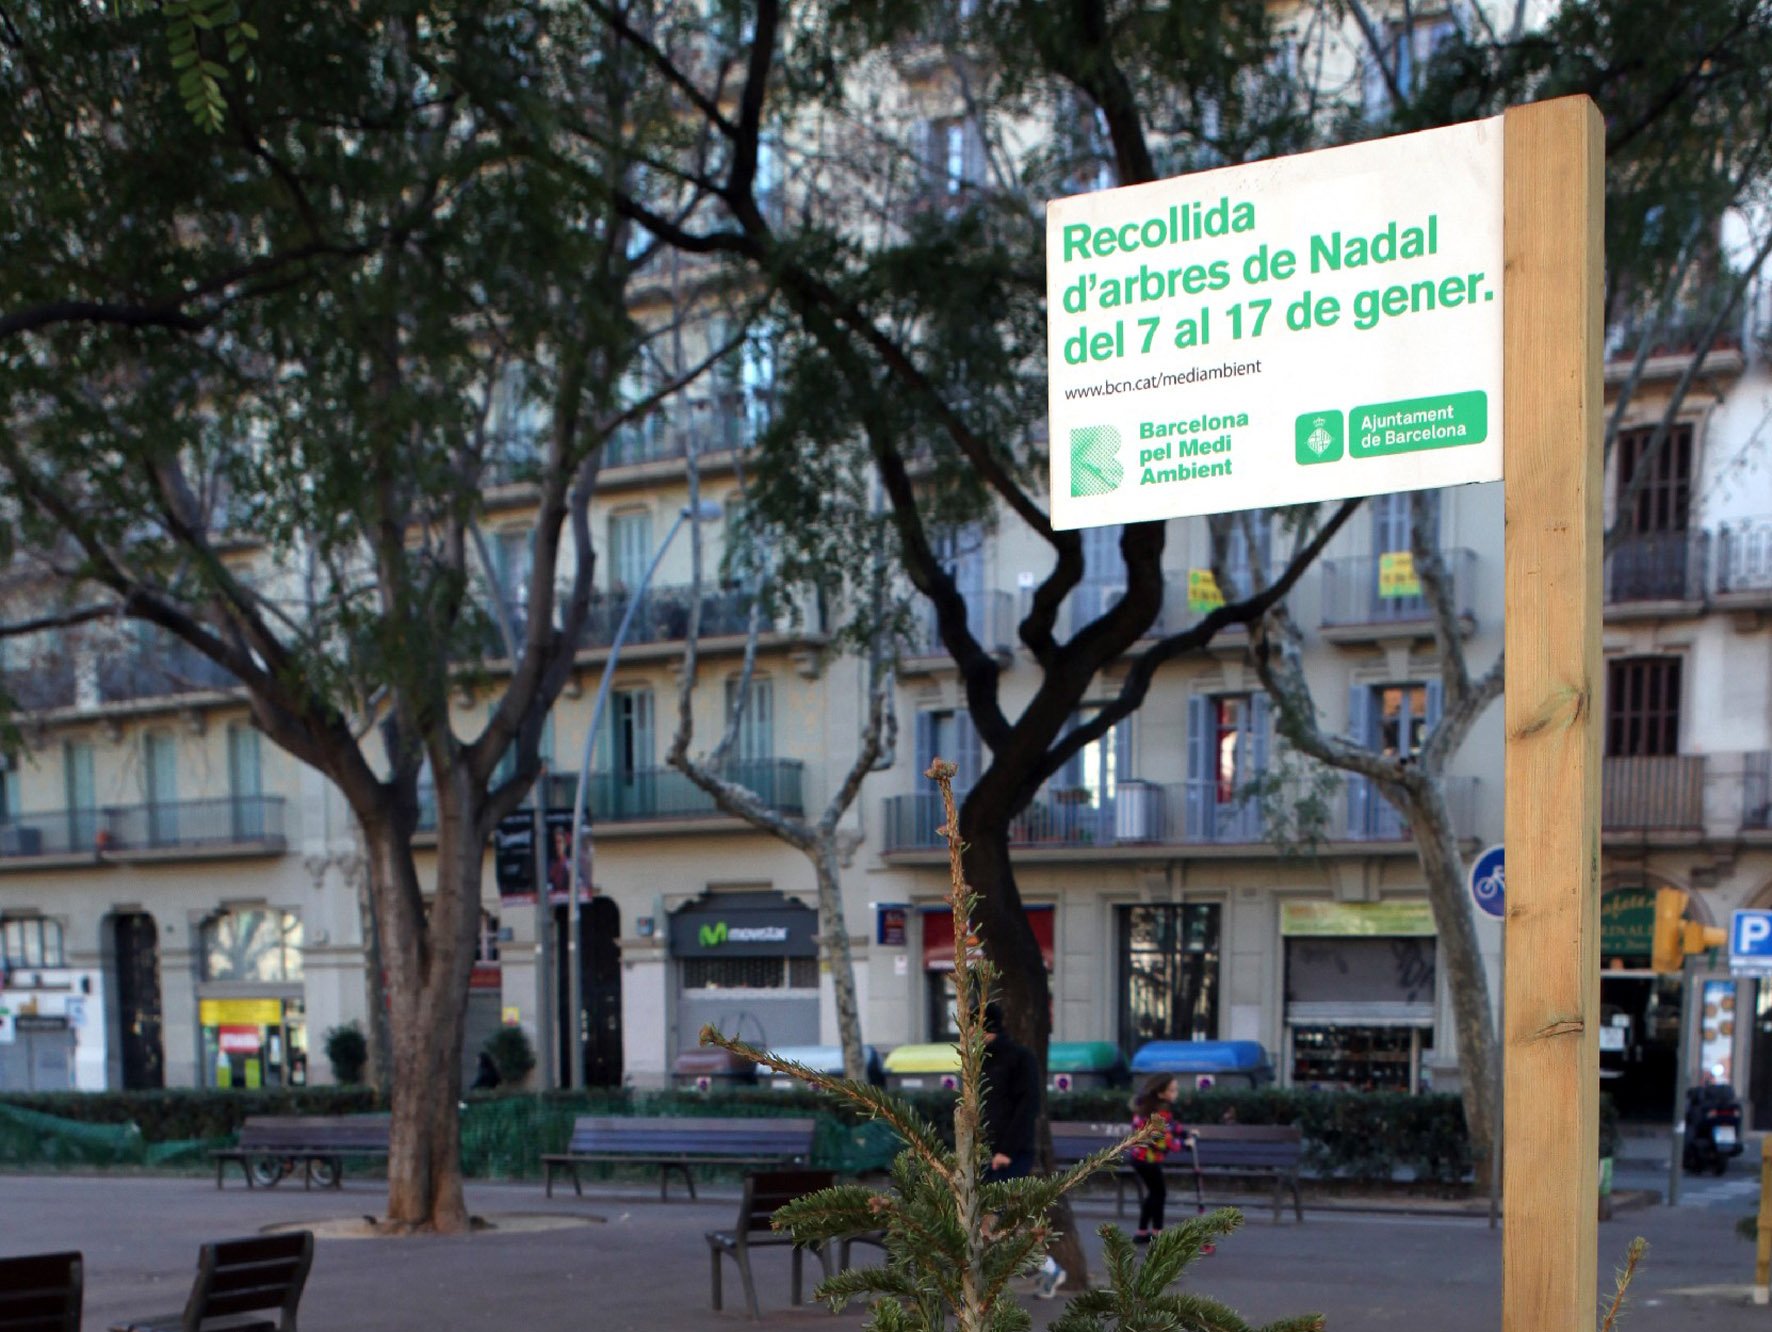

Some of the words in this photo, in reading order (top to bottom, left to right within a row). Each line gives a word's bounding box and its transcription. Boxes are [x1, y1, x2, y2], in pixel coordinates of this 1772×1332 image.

[1063, 196, 1255, 260] Recollida
[1243, 244, 1296, 283] de
[1311, 214, 1437, 272] Nadal
[1064, 316, 1124, 364] del
[1138, 316, 1160, 352] 7
[1176, 306, 1209, 347] al
[1226, 298, 1272, 338] 17
[1287, 290, 1340, 330] de
[1354, 273, 1493, 329] gener.
[1065, 359, 1262, 400] www.bcn.cat/mediambient
[1140, 412, 1248, 439] Barcelona
[1361, 405, 1454, 432] Ajuntament
[1140, 442, 1171, 466] pel
[1179, 435, 1231, 457] Medi
[1361, 433, 1381, 448] de
[1385, 424, 1466, 446] Barcelona
[1140, 458, 1232, 485] Ambient
[1740, 916, 1771, 953] P
